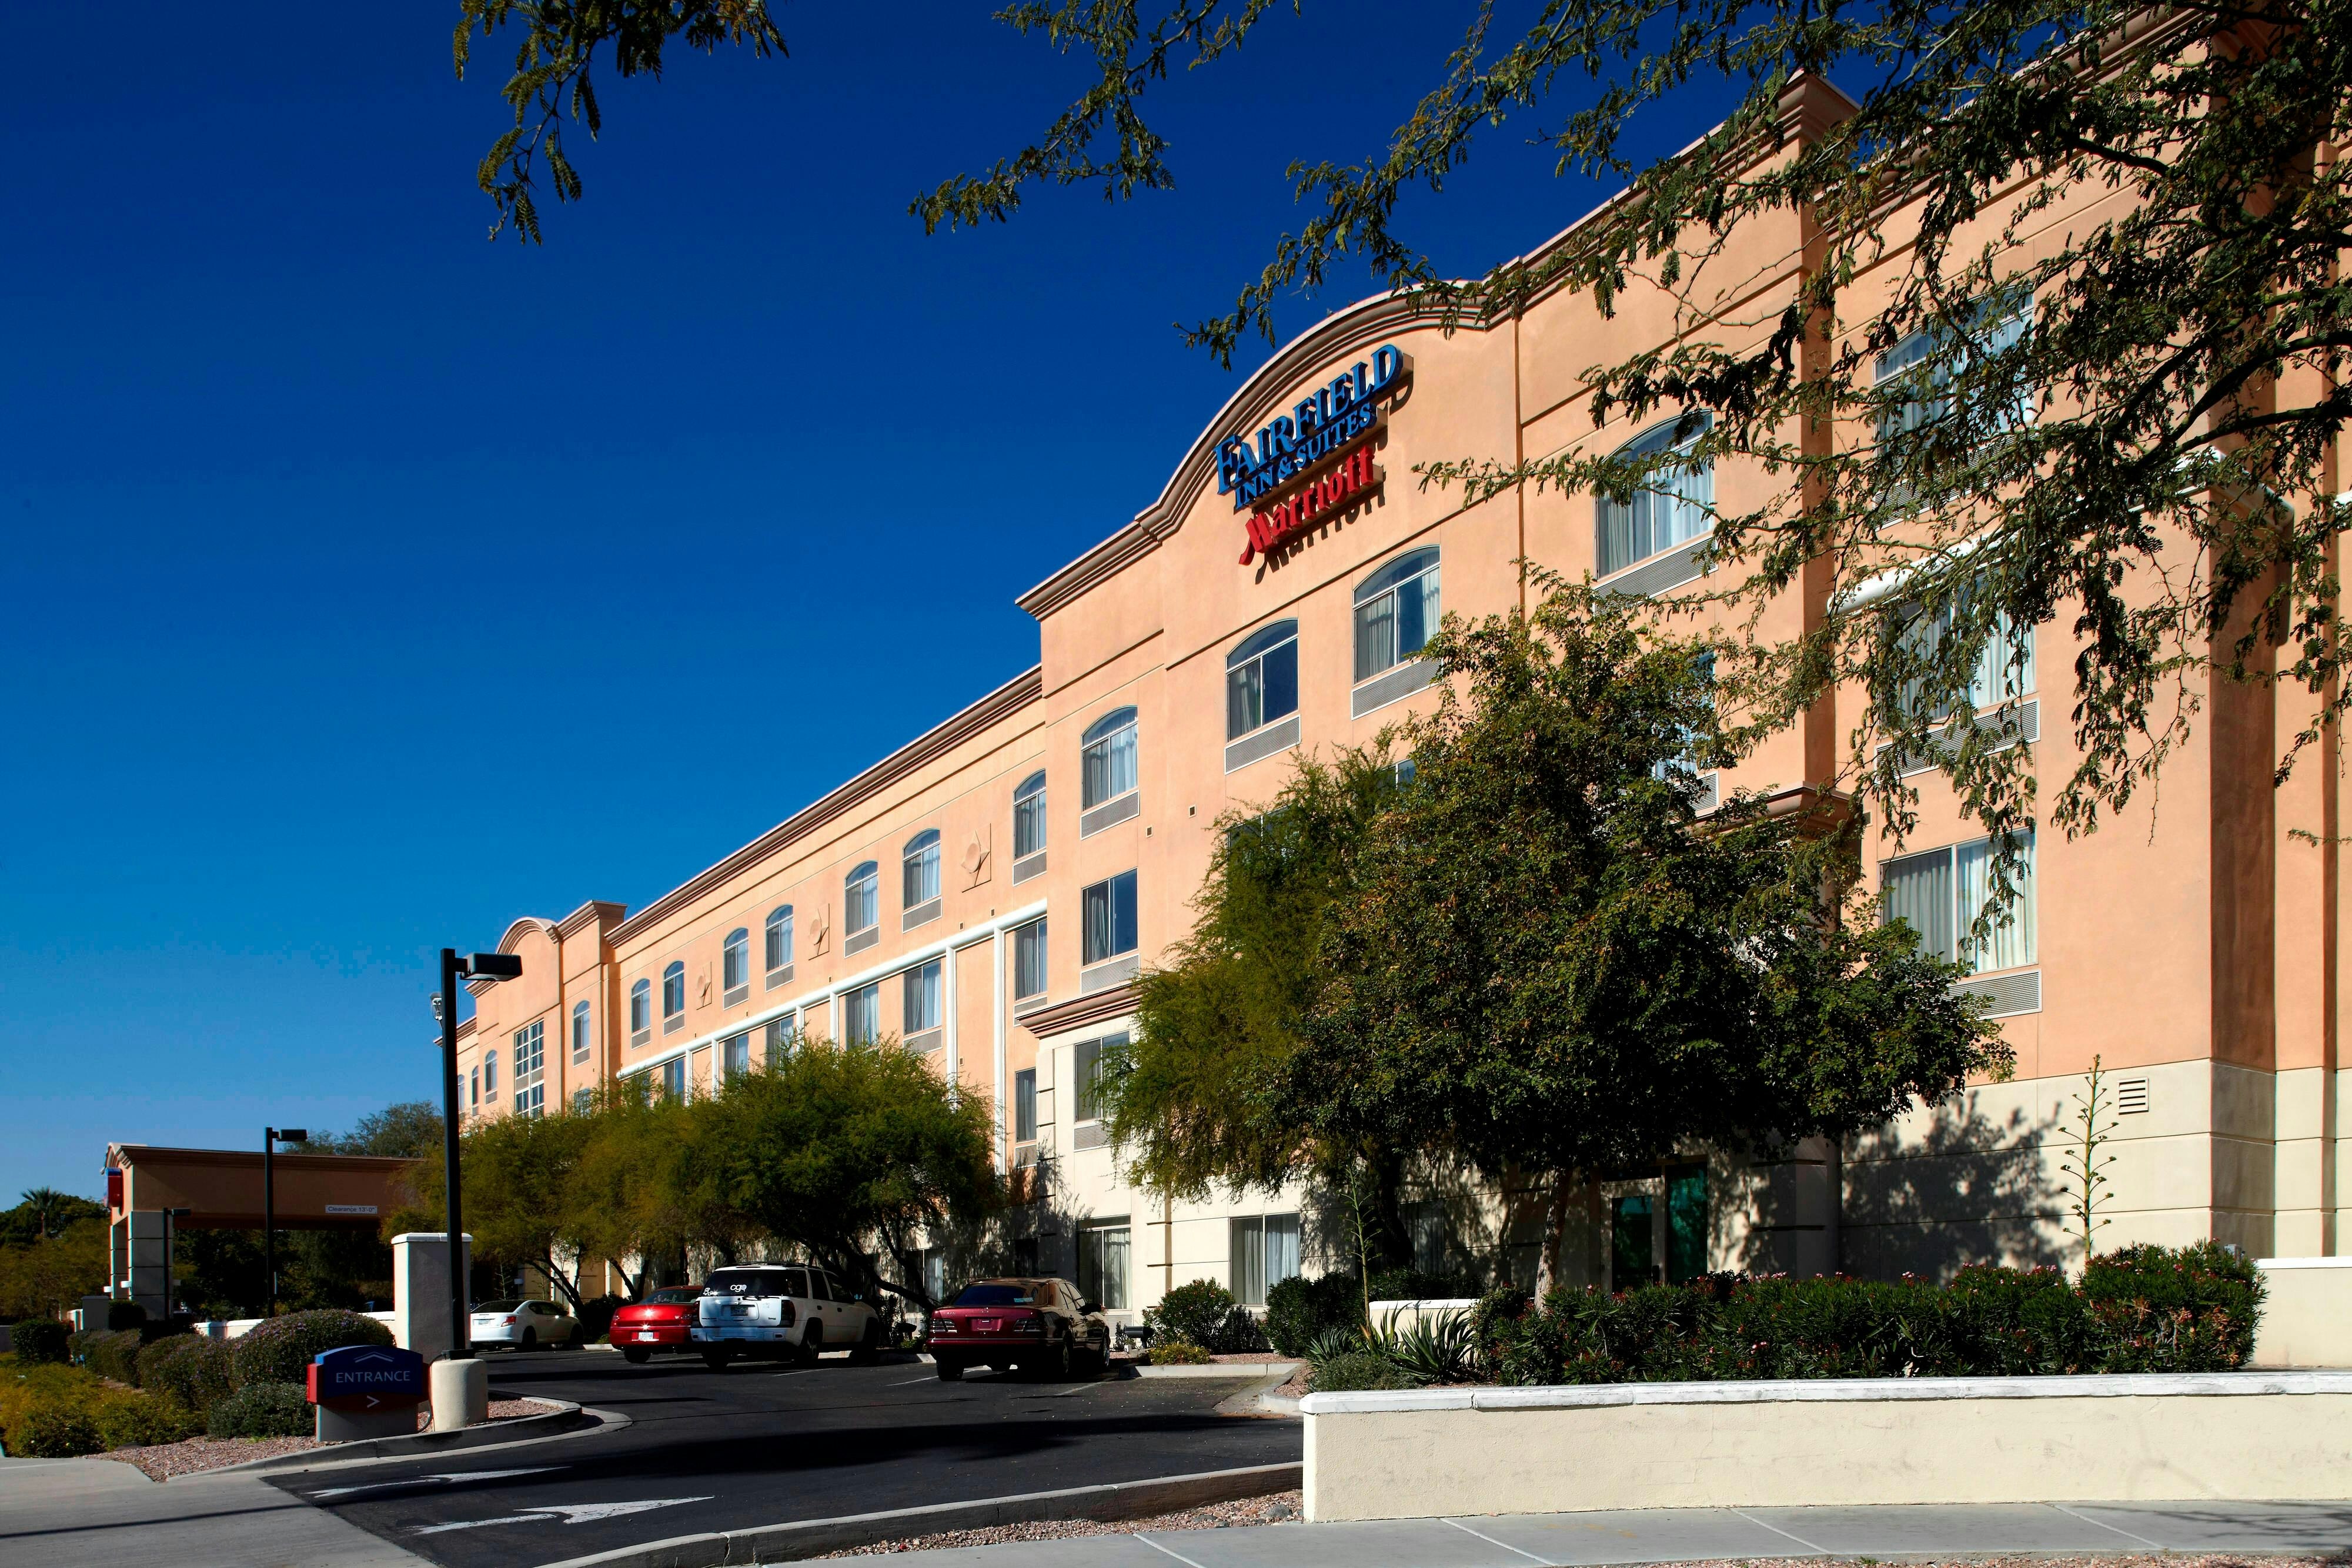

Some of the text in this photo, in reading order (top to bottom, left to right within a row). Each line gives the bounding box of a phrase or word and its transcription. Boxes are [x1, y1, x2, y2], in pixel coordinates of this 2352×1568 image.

[1212, 344, 1403, 494] FAIRFIELD
[1296, 402, 1375, 468] SUITES
[1238, 446, 1374, 566] Marriott
[336, 1370, 410, 1383] ENTRANCE
